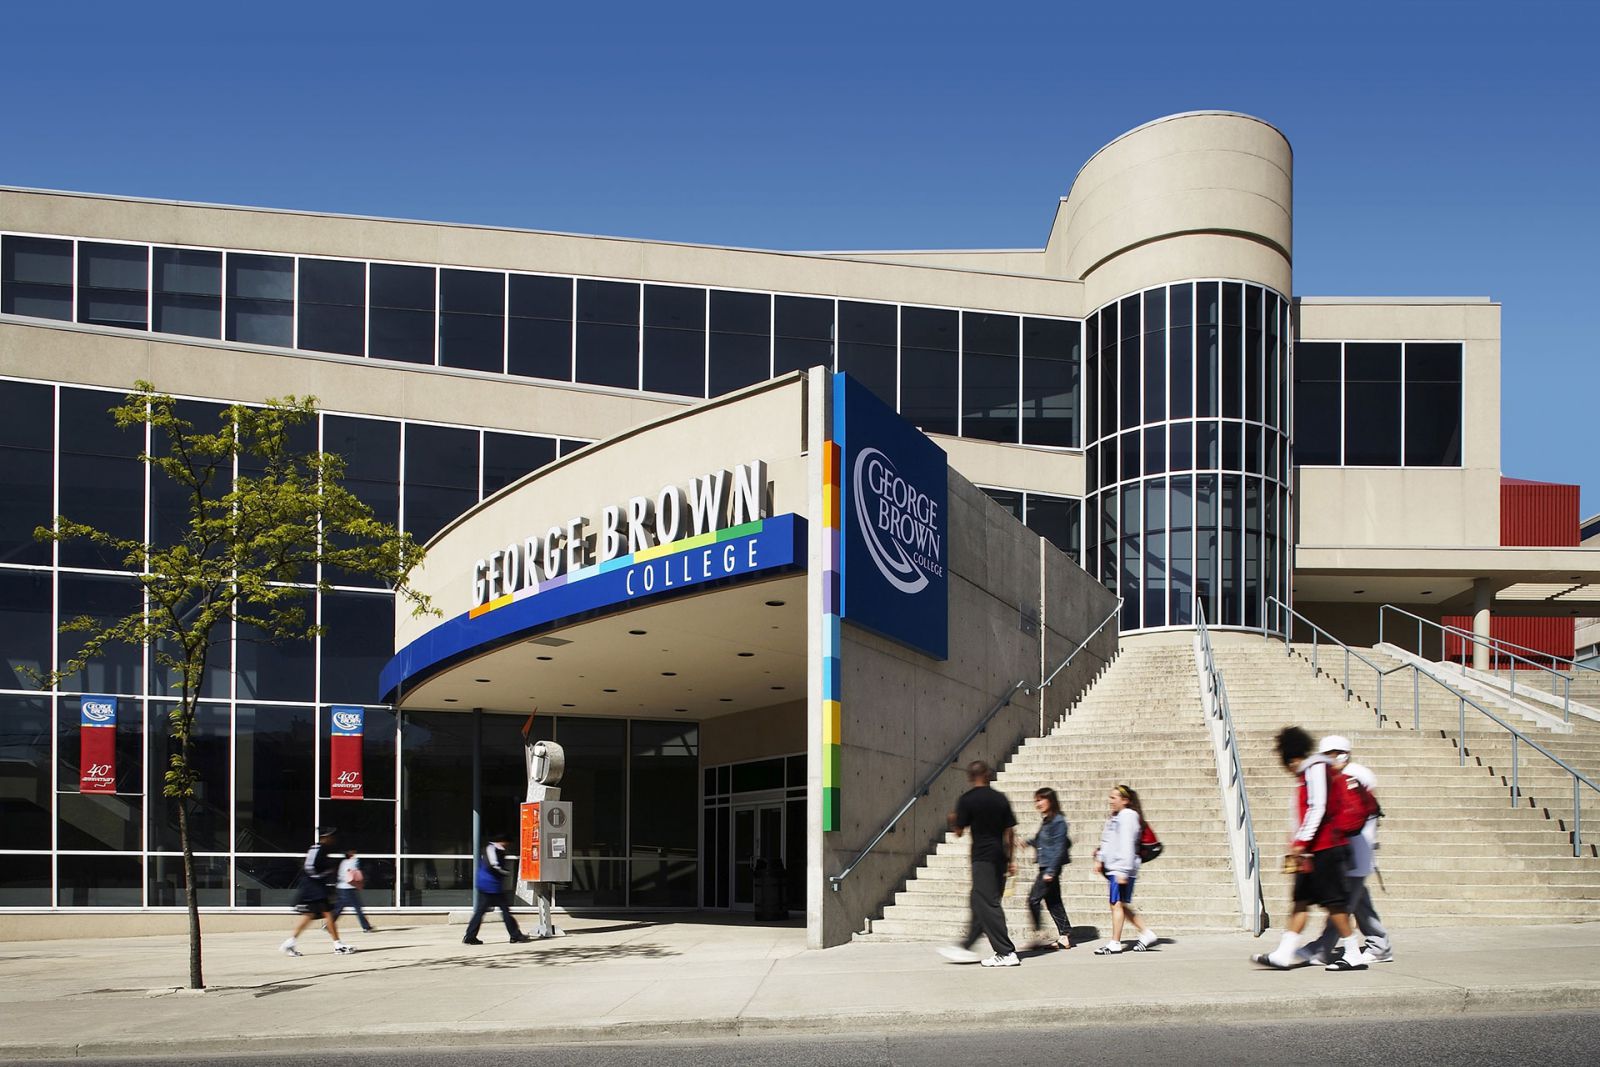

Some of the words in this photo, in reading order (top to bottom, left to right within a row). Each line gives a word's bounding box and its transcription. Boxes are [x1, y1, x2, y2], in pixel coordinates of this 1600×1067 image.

[868, 459, 938, 531] GEORGE
[472, 516, 588, 607] GEORGE
[602, 459, 767, 561] BROWN
[878, 497, 941, 562] BROWN
[626, 539, 758, 596] COLLEGE
[913, 551, 943, 578] COLLEGE
